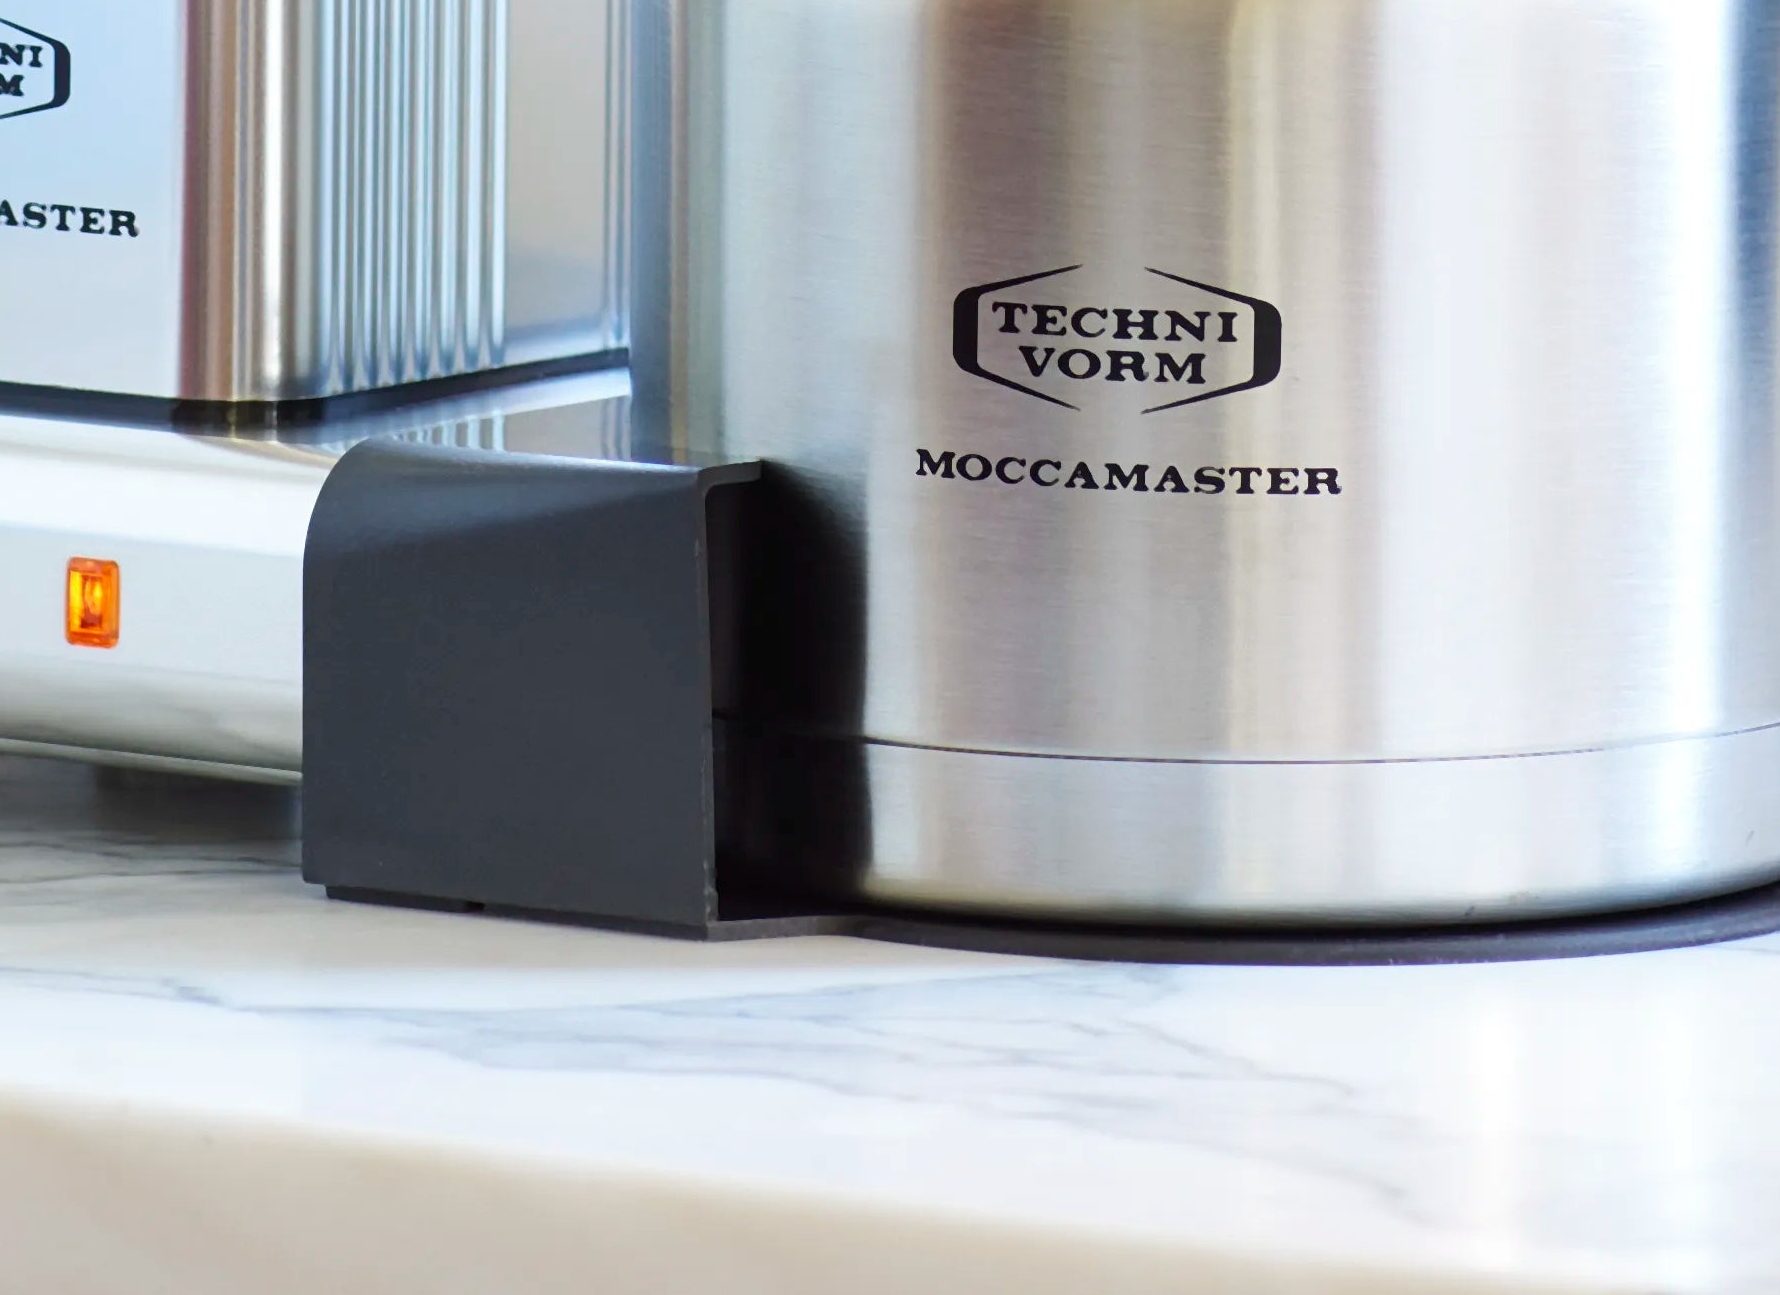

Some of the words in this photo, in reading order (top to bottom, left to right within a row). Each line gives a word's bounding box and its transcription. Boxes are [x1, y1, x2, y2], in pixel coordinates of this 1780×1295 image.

[991, 300, 1240, 344] TECHNI
[1017, 344, 1207, 385] VORM
[915, 448, 1341, 495] MOCCAMASTER
